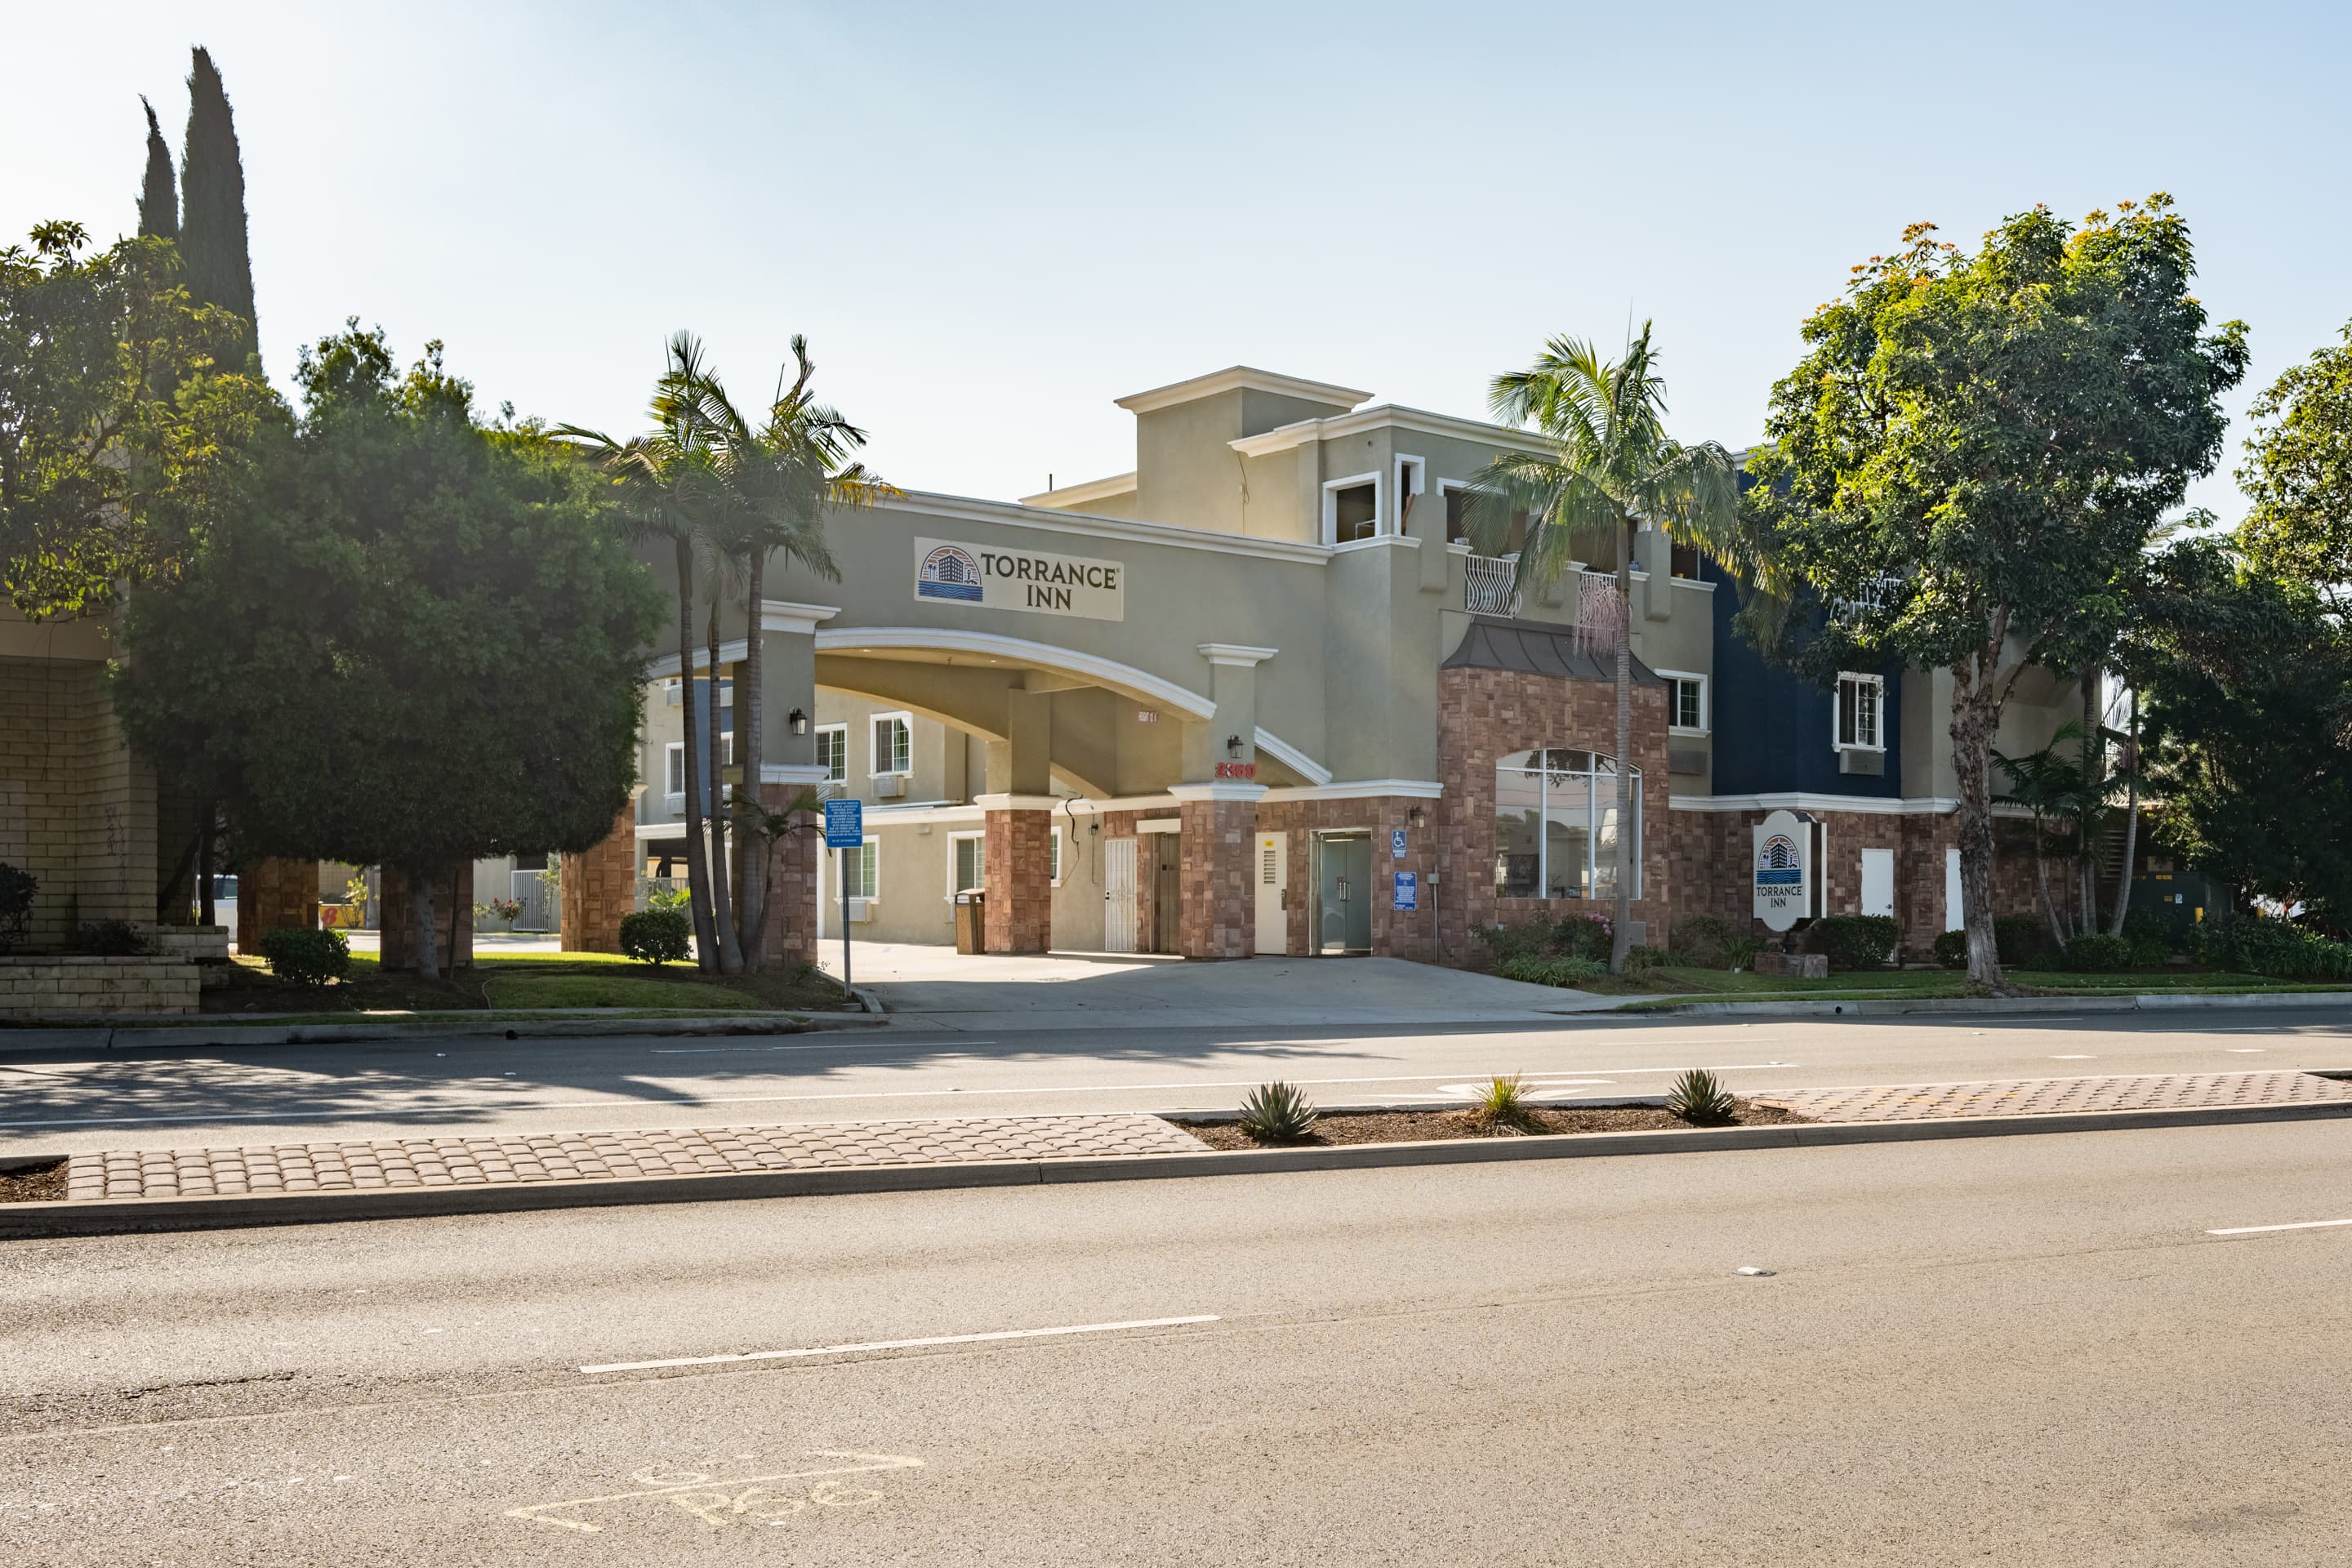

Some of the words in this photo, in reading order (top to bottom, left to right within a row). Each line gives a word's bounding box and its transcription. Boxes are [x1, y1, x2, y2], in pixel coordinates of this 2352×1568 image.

[981, 553, 1117, 590] TORRANCE
[1027, 585, 1071, 611] INN
[1757, 885, 1802, 897] TORRANCE
[1771, 898, 1787, 908] INN
